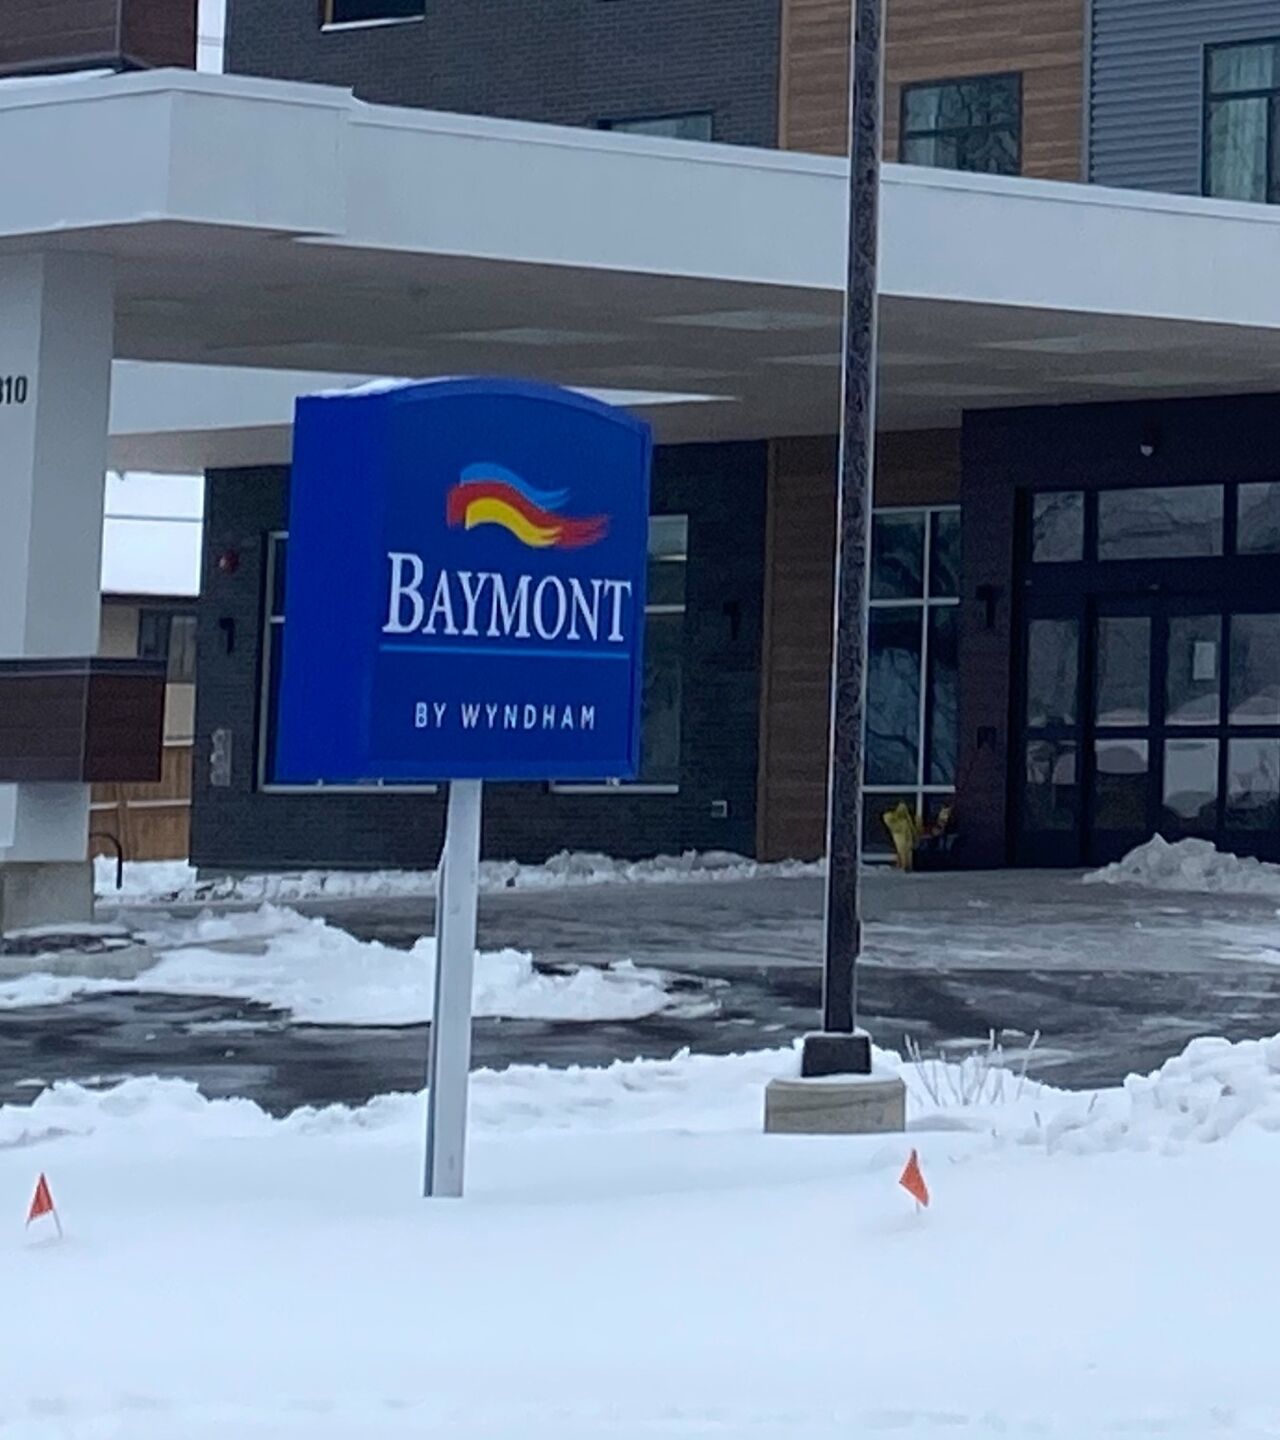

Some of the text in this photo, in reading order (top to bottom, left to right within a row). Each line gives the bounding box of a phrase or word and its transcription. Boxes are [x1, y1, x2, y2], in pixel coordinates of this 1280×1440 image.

[382, 551, 632, 642] BAYMONT
[414, 701, 596, 730] BY WYNDHAM
